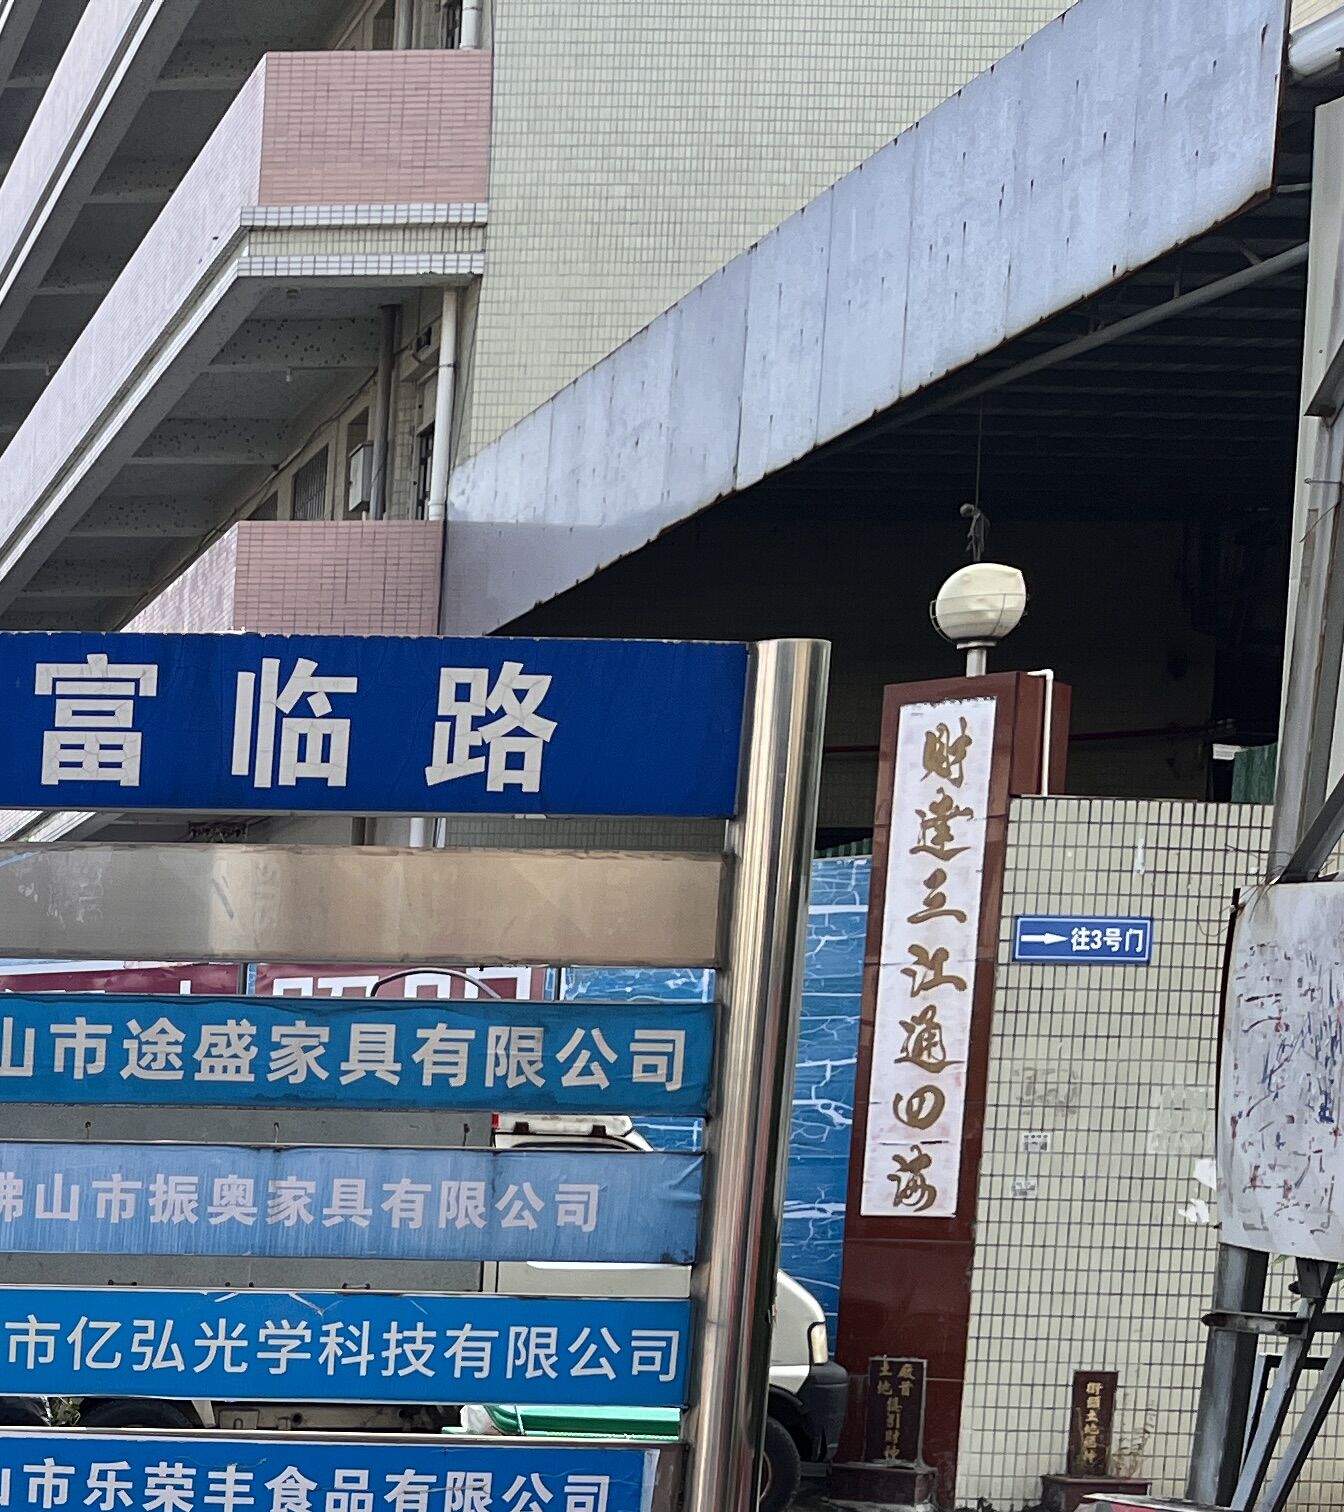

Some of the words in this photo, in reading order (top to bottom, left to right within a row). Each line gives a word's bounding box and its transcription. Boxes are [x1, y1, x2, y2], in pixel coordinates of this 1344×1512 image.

[35, 654, 558, 793] 富临路
[1070, 926, 1144, 953] 往3号门
